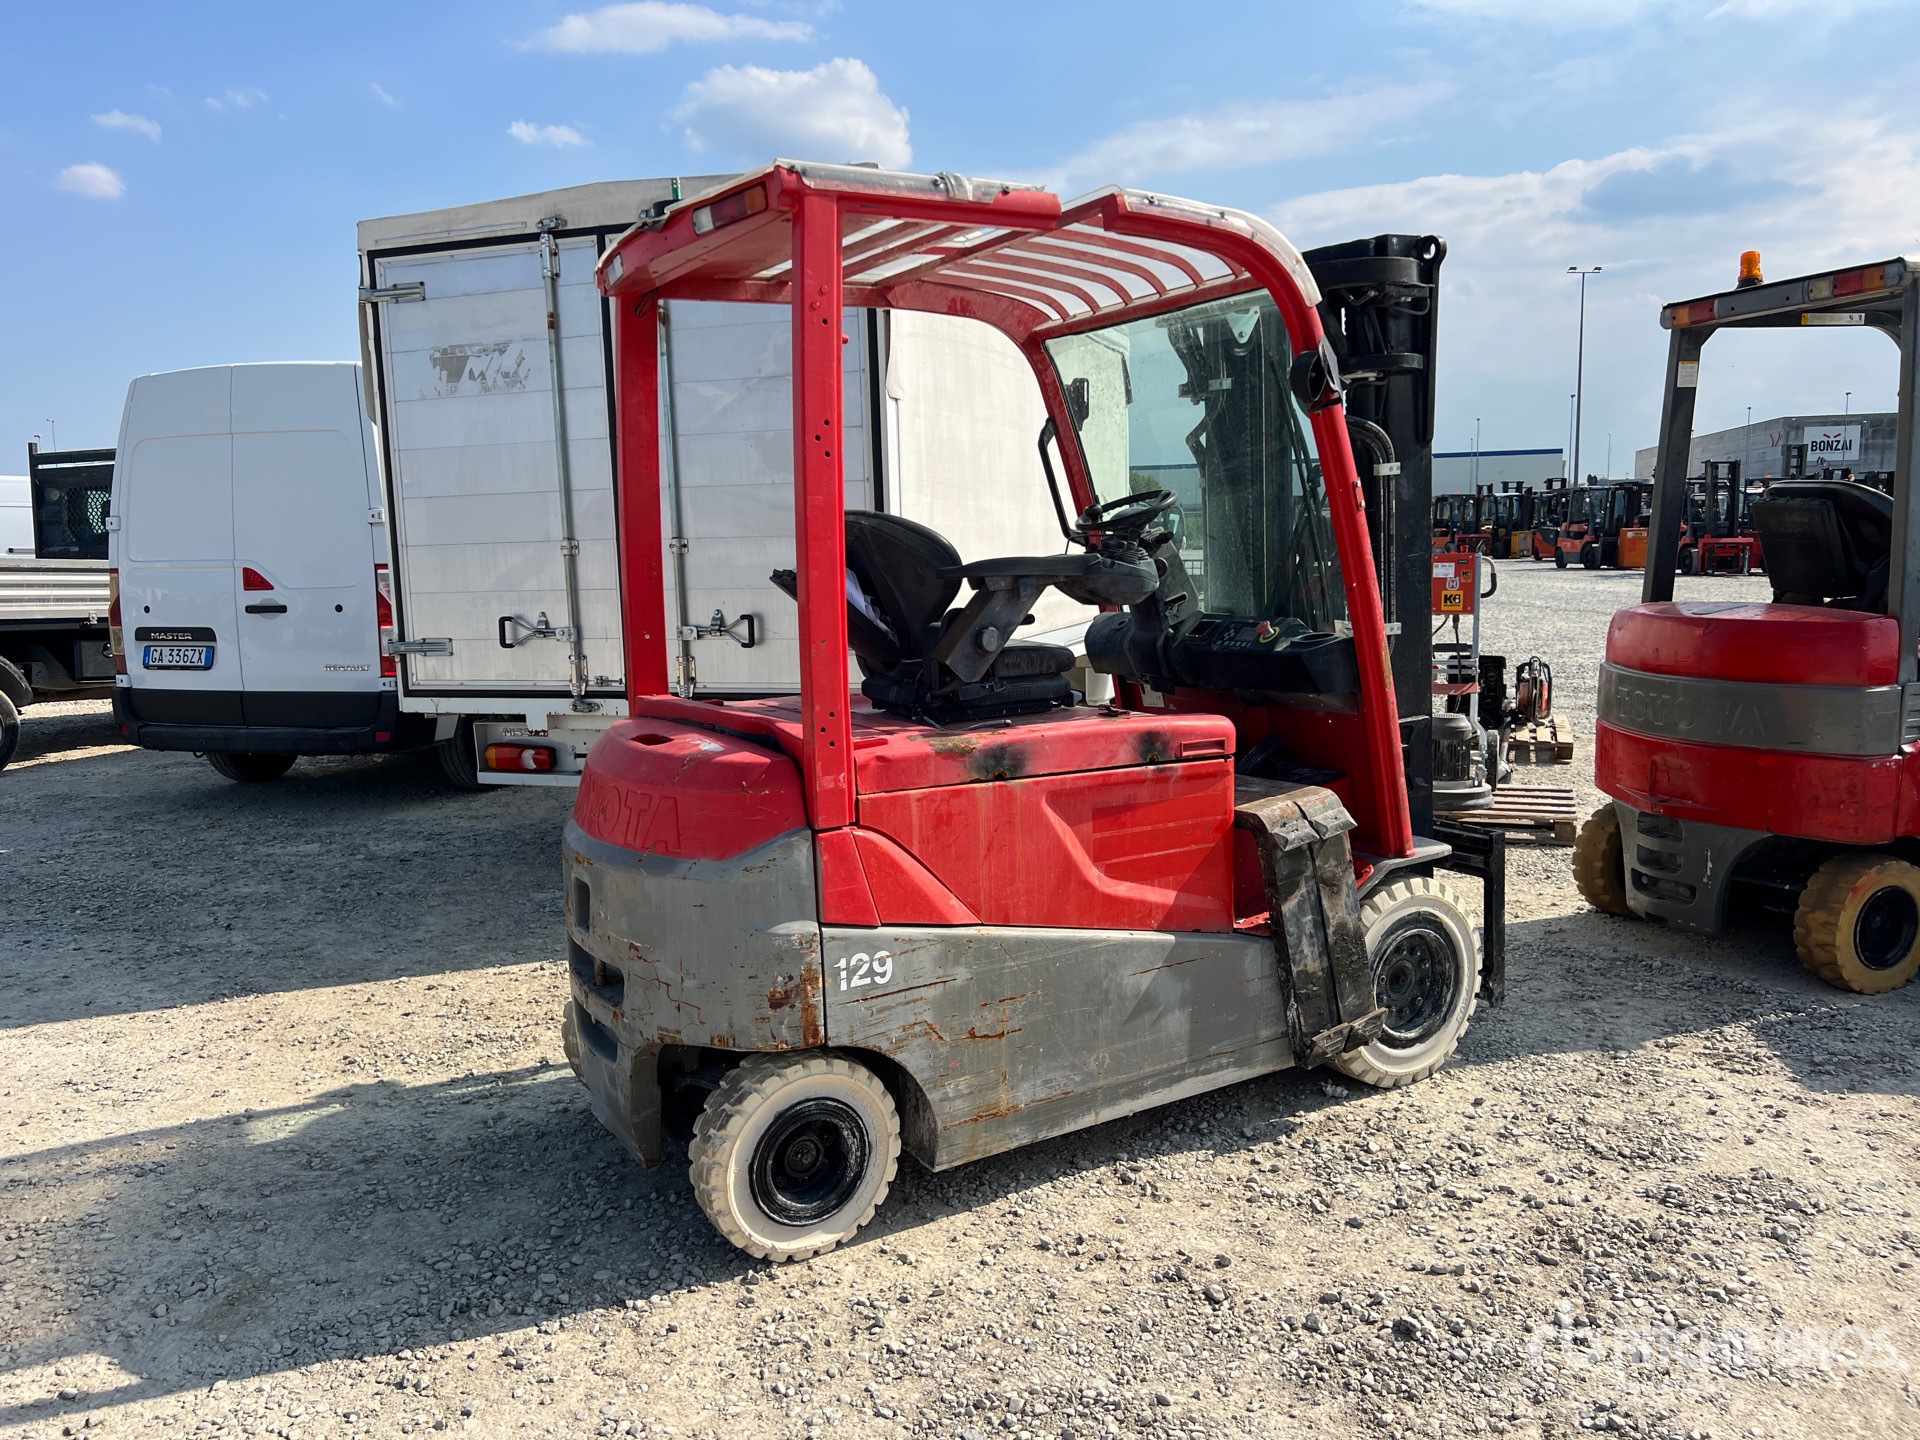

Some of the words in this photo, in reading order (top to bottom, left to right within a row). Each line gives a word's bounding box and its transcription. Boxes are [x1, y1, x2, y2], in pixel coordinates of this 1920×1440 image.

[1811, 439, 1852, 452] BONZAI
[150, 632, 193, 640] MASTER
[151, 648, 164, 664] GA
[167, 648, 204, 664] 336ZX
[833, 950, 893, 991] 129
